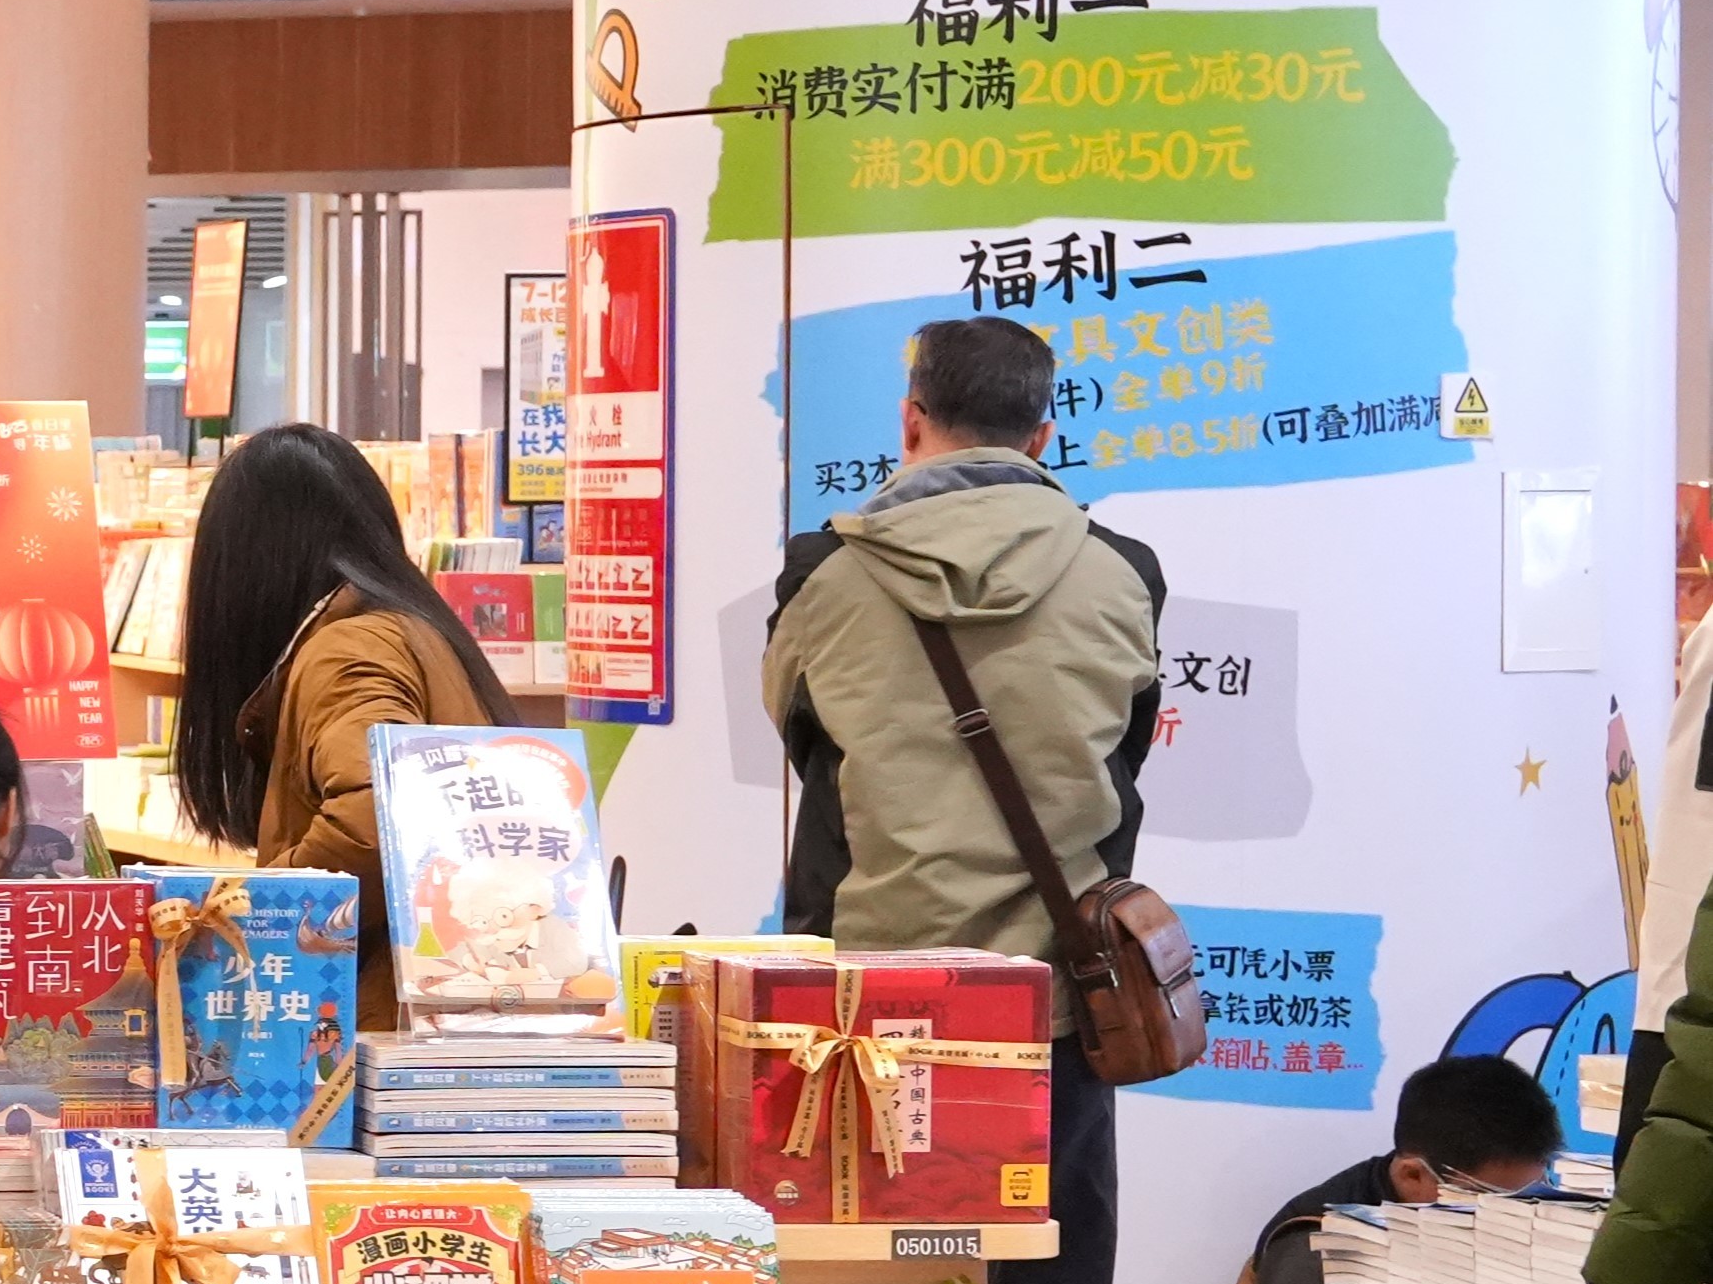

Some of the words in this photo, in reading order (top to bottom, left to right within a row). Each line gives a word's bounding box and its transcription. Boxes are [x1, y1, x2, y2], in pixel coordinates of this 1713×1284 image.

[849, 125, 1256, 192] 满300元减50元
[959, 229, 1209, 311] 福利二
[69, 680, 101, 693] HAPPY
[80, 697, 101, 709] NEW
[78, 713, 103, 725] YEAR
[221, 953, 295, 984] 少年
[204, 991, 312, 1023] 世界史
[355, 1231, 493, 1264] 漫画小学生
[895, 1237, 978, 1256] 0501015
